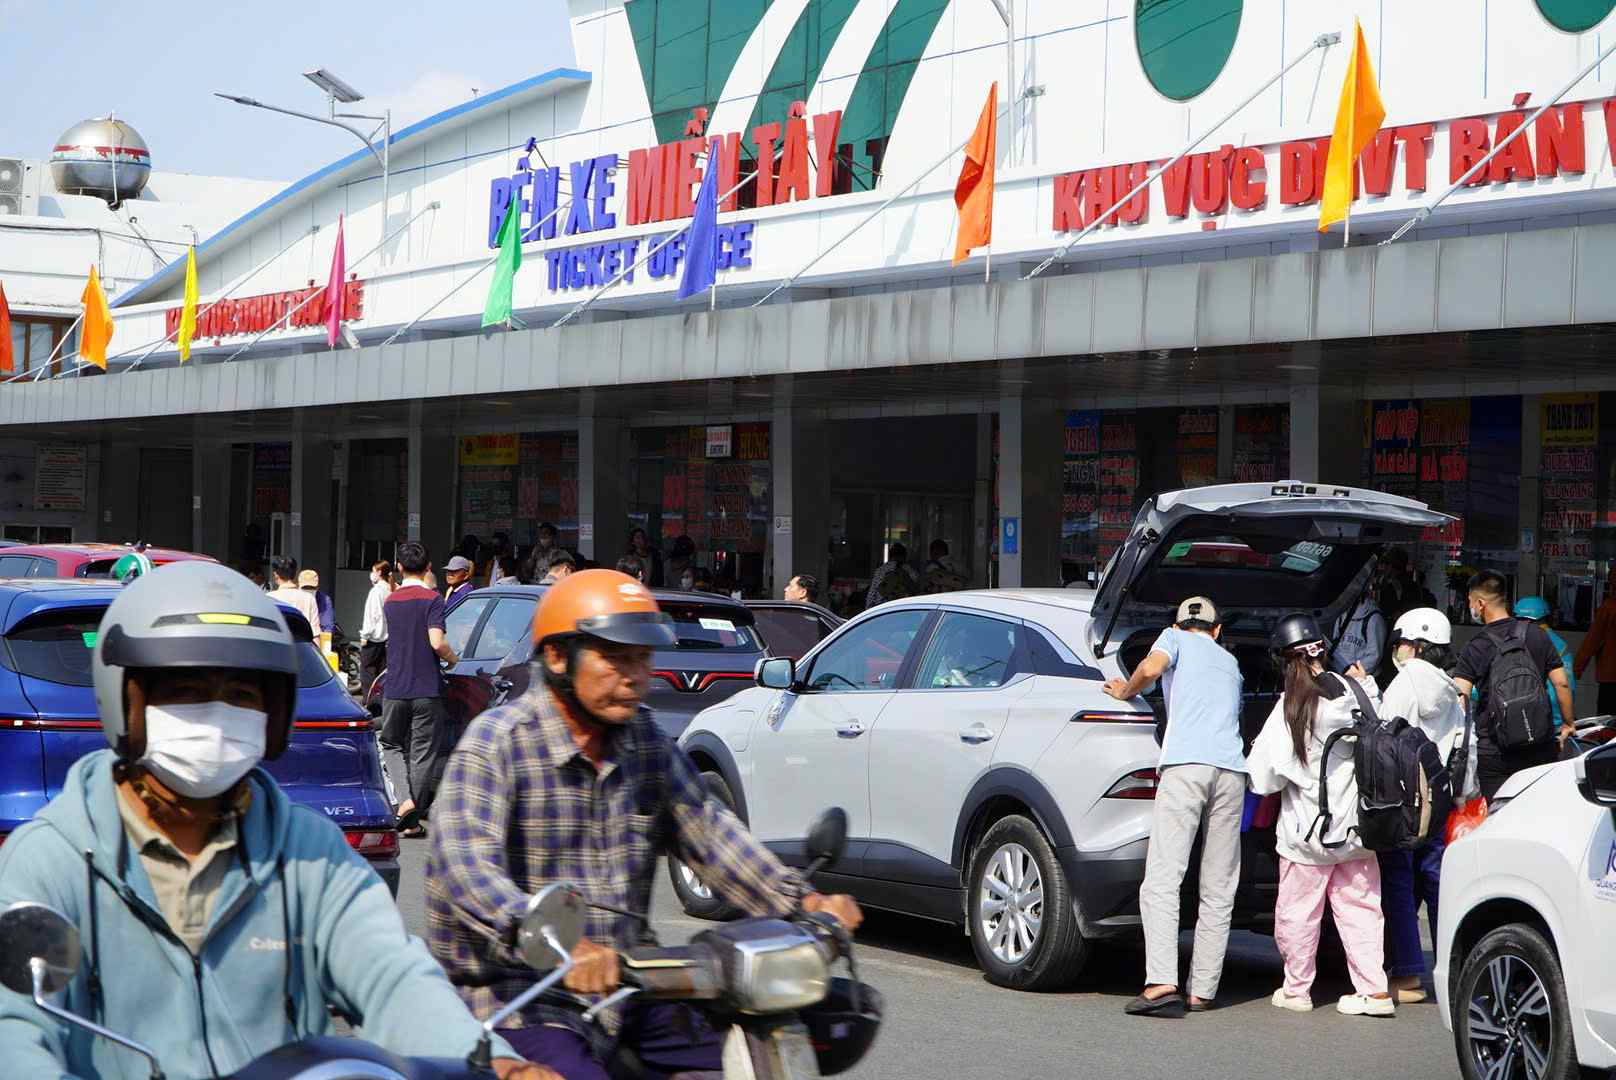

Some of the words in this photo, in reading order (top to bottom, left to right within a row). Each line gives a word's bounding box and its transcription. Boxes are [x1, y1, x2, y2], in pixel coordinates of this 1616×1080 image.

[488, 136, 560, 249] BẾN
[563, 153, 618, 235] XE
[626, 107, 741, 226] MIỀN
[752, 100, 842, 209] TÂY
[1052, 162, 1150, 231] KHU
[1160, 144, 1268, 231] VỰC
[1450, 92, 1585, 187] BÁN
[544, 236, 640, 291] TICKET
[647, 222, 755, 279] OFCE
[323, 806, 354, 815] VF5
